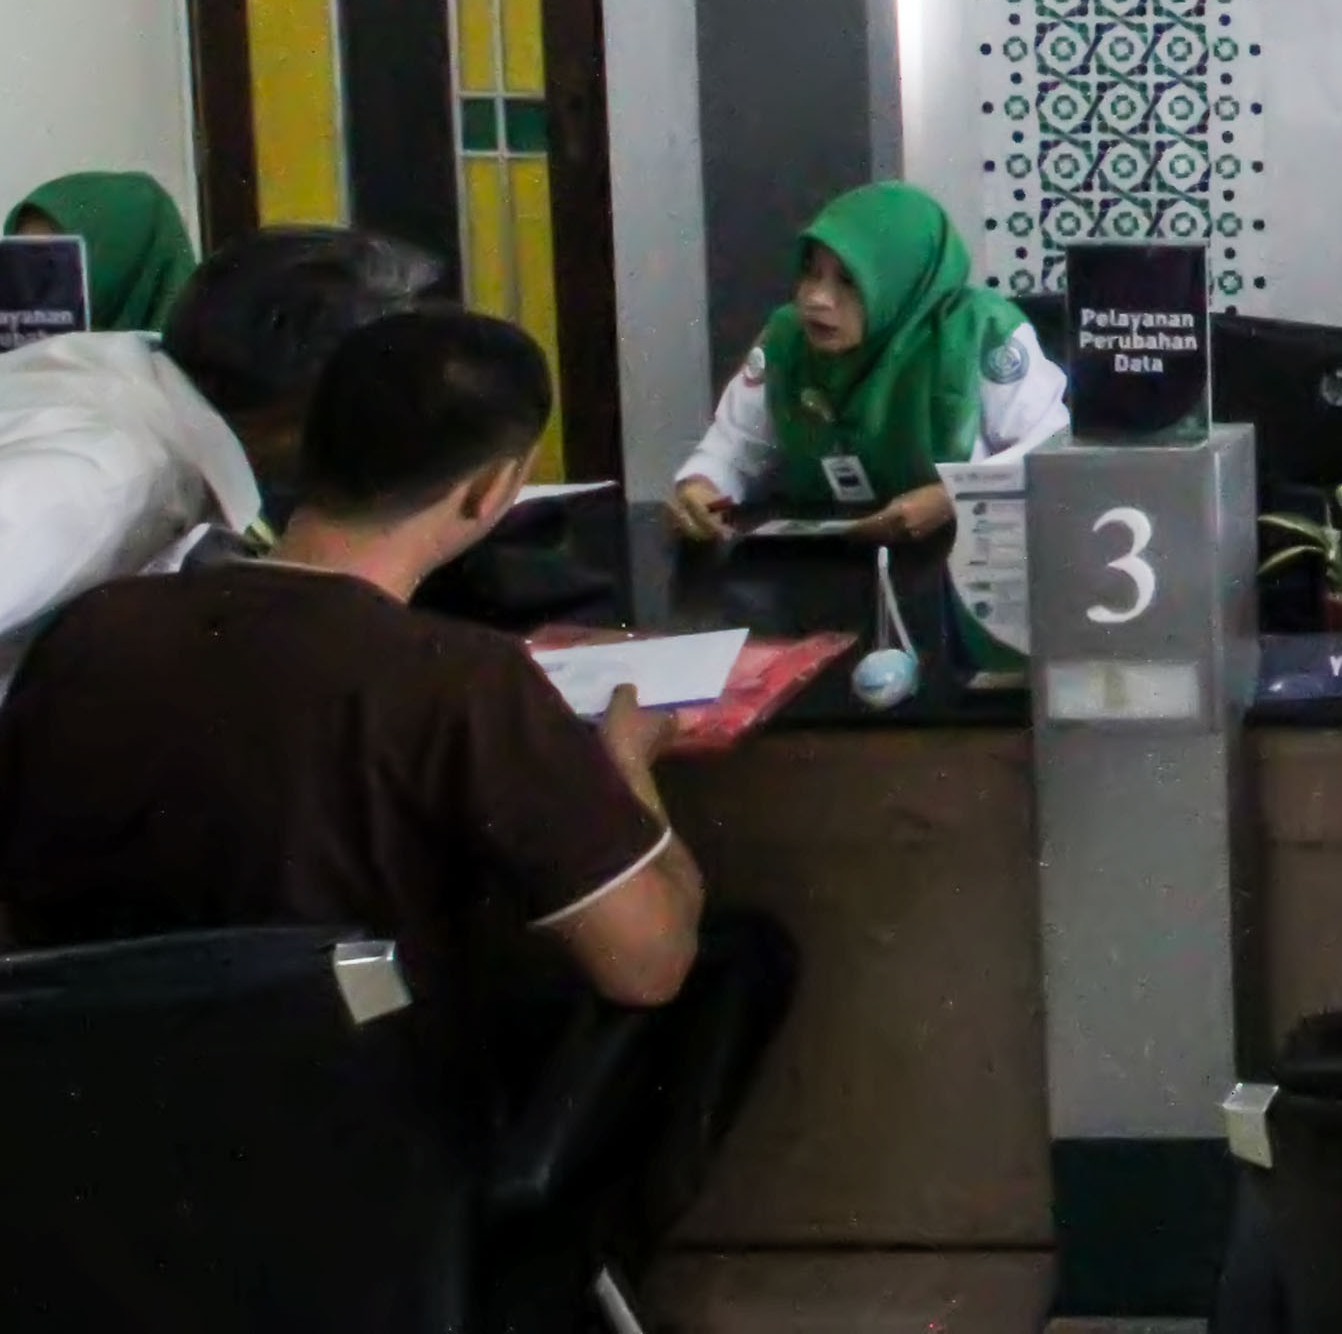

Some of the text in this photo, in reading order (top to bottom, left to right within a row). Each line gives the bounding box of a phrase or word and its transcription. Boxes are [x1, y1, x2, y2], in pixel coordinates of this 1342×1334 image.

[1081, 308, 1195, 330] Pelayanan
[1079, 331, 1198, 350] Perubahan
[1114, 353, 1164, 373] Data
[1085, 506, 1157, 623] 3
